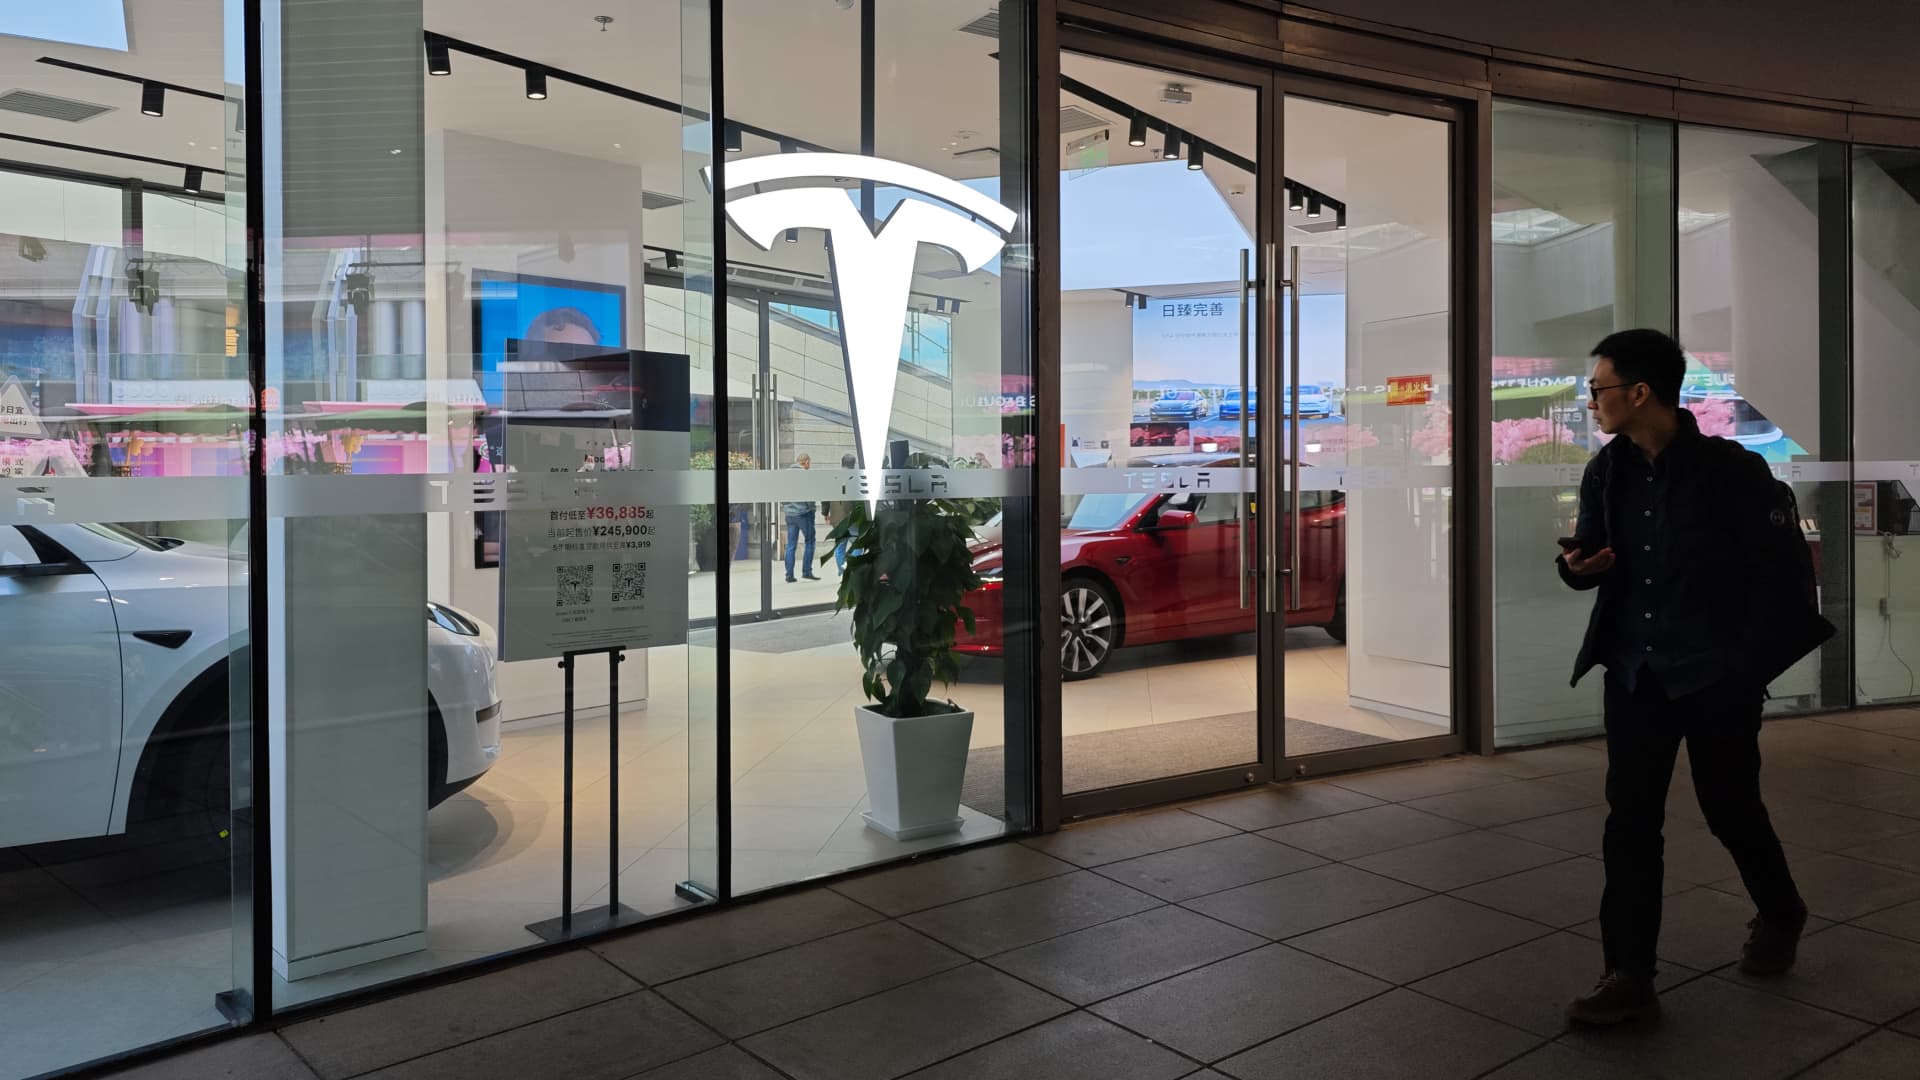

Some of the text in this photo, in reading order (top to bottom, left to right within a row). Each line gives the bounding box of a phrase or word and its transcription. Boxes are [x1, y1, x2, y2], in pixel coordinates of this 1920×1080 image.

[1162, 302, 1224, 318] 日臻完善
[1124, 472, 1210, 489] TESLA
